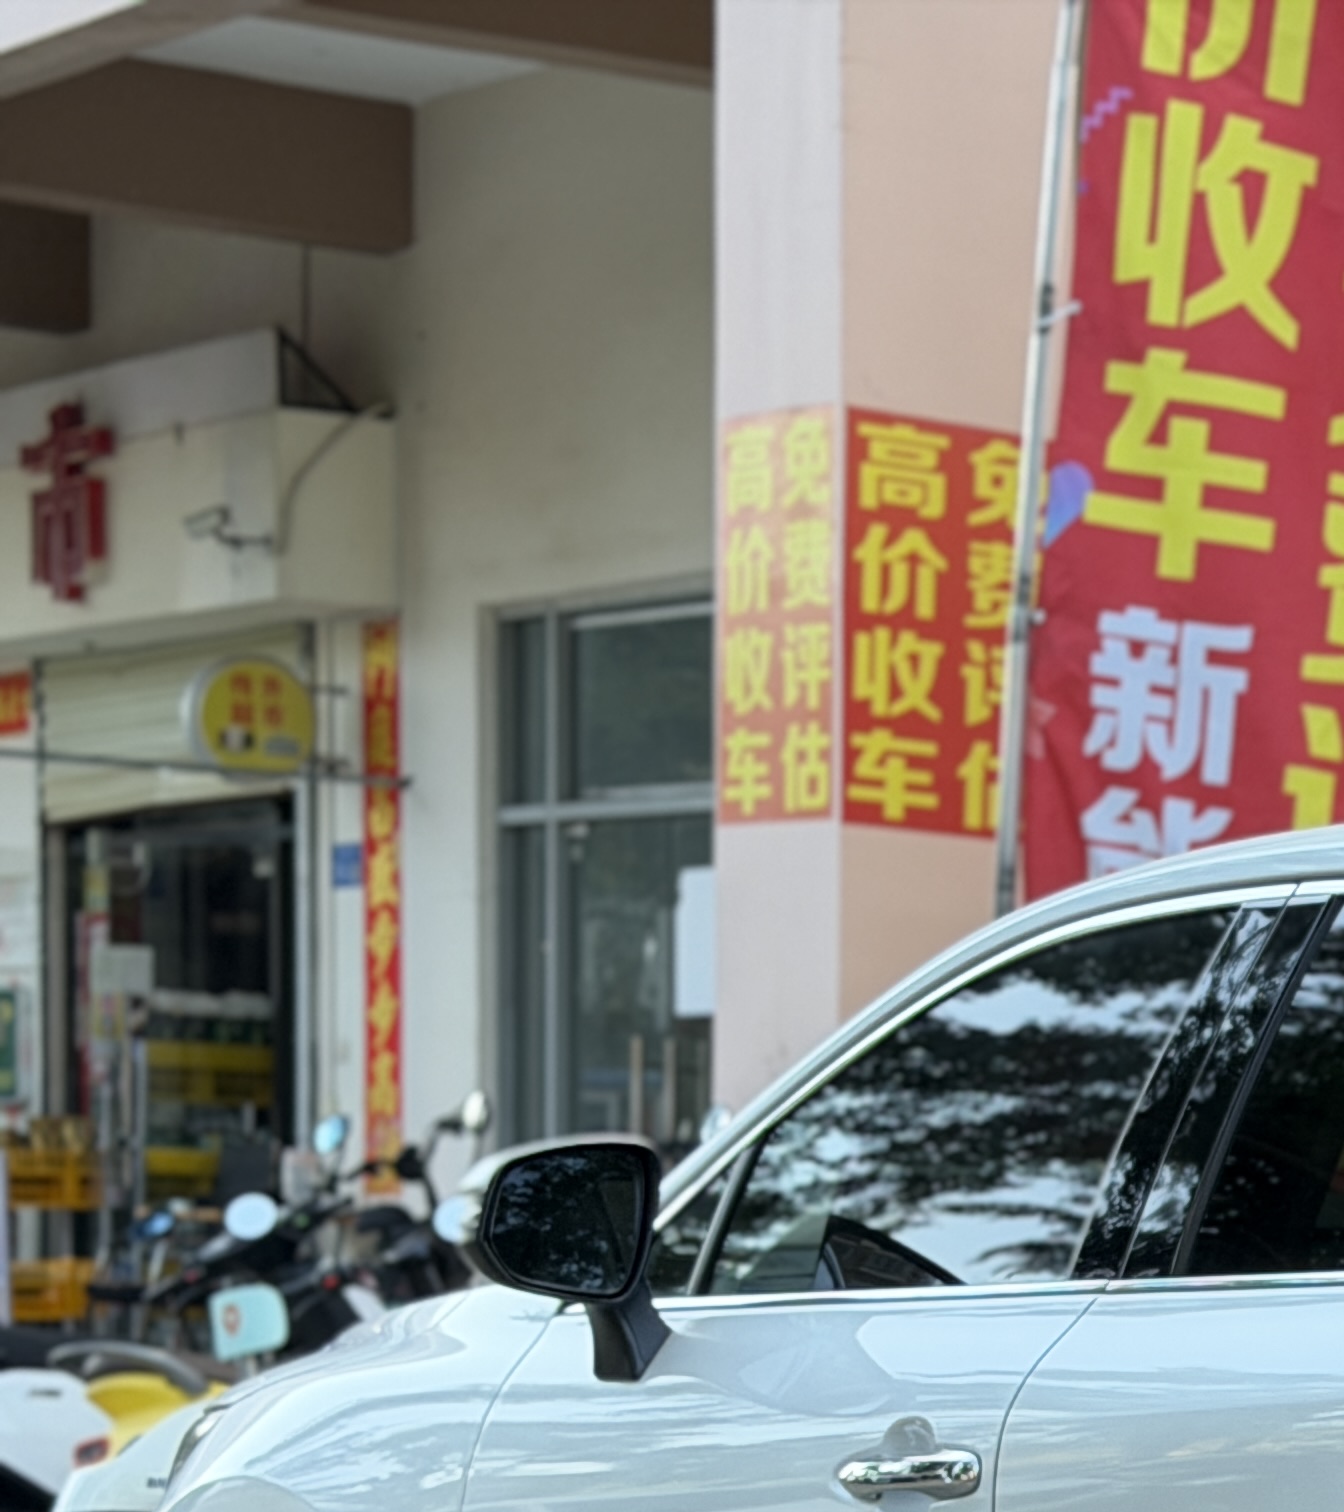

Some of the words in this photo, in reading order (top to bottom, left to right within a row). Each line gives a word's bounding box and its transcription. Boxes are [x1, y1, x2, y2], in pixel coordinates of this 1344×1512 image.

[723, 423, 775, 817] 高价收车
[780, 415, 832, 814] 免费评估
[846, 418, 950, 821] 高价收车
